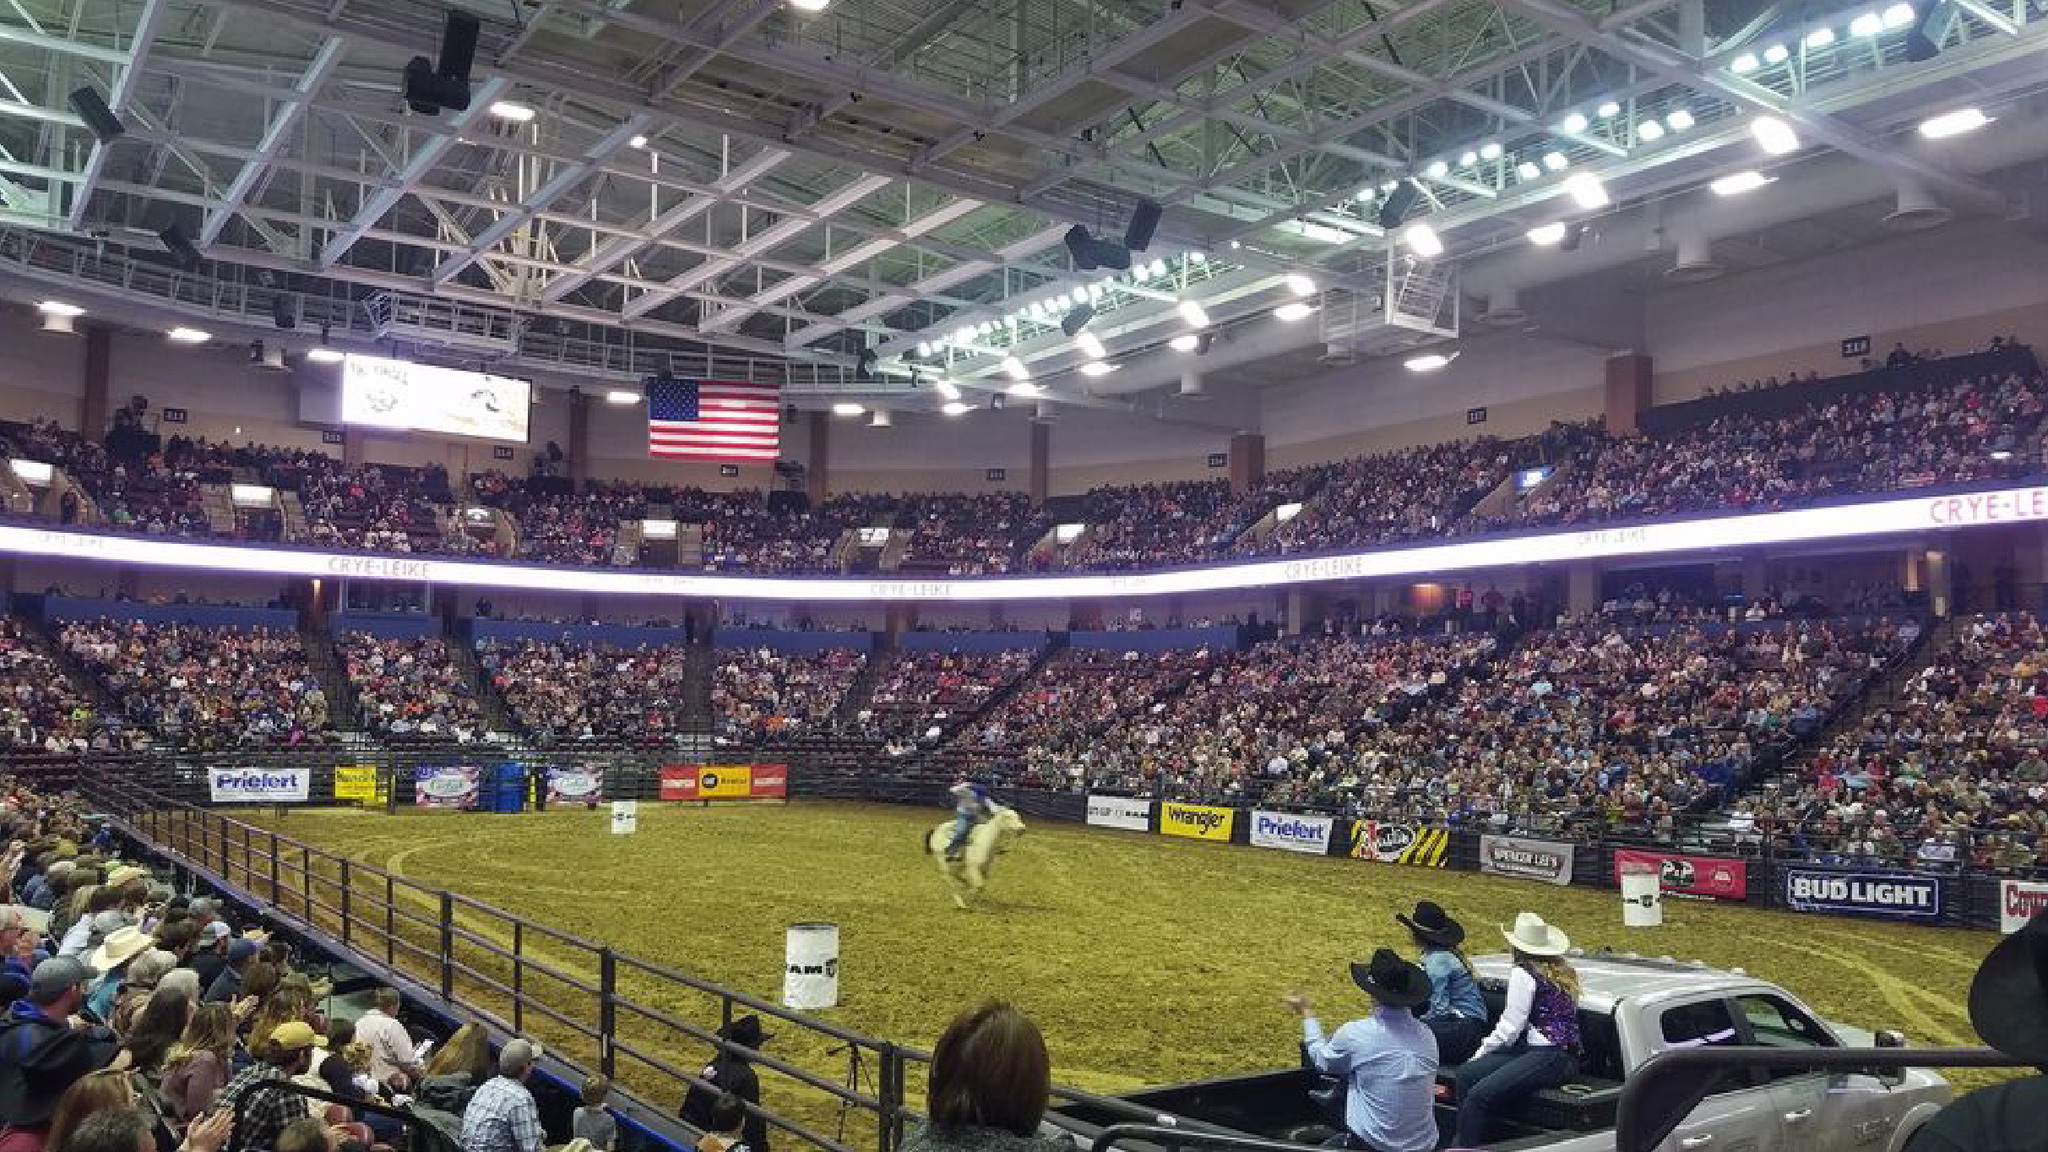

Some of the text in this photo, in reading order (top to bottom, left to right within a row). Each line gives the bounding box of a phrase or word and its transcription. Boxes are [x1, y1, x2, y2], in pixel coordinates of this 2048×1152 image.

[327, 556, 430, 578] CRYE-LEIKE
[1284, 556, 1363, 580] CRYE-LEIKE
[216, 771, 298, 789] Priefert
[1168, 805, 1226, 836] Wrangler
[1257, 815, 1325, 840] Priefert
[1793, 878, 1931, 905] BUD LIGHT
[786, 963, 823, 974] AM
